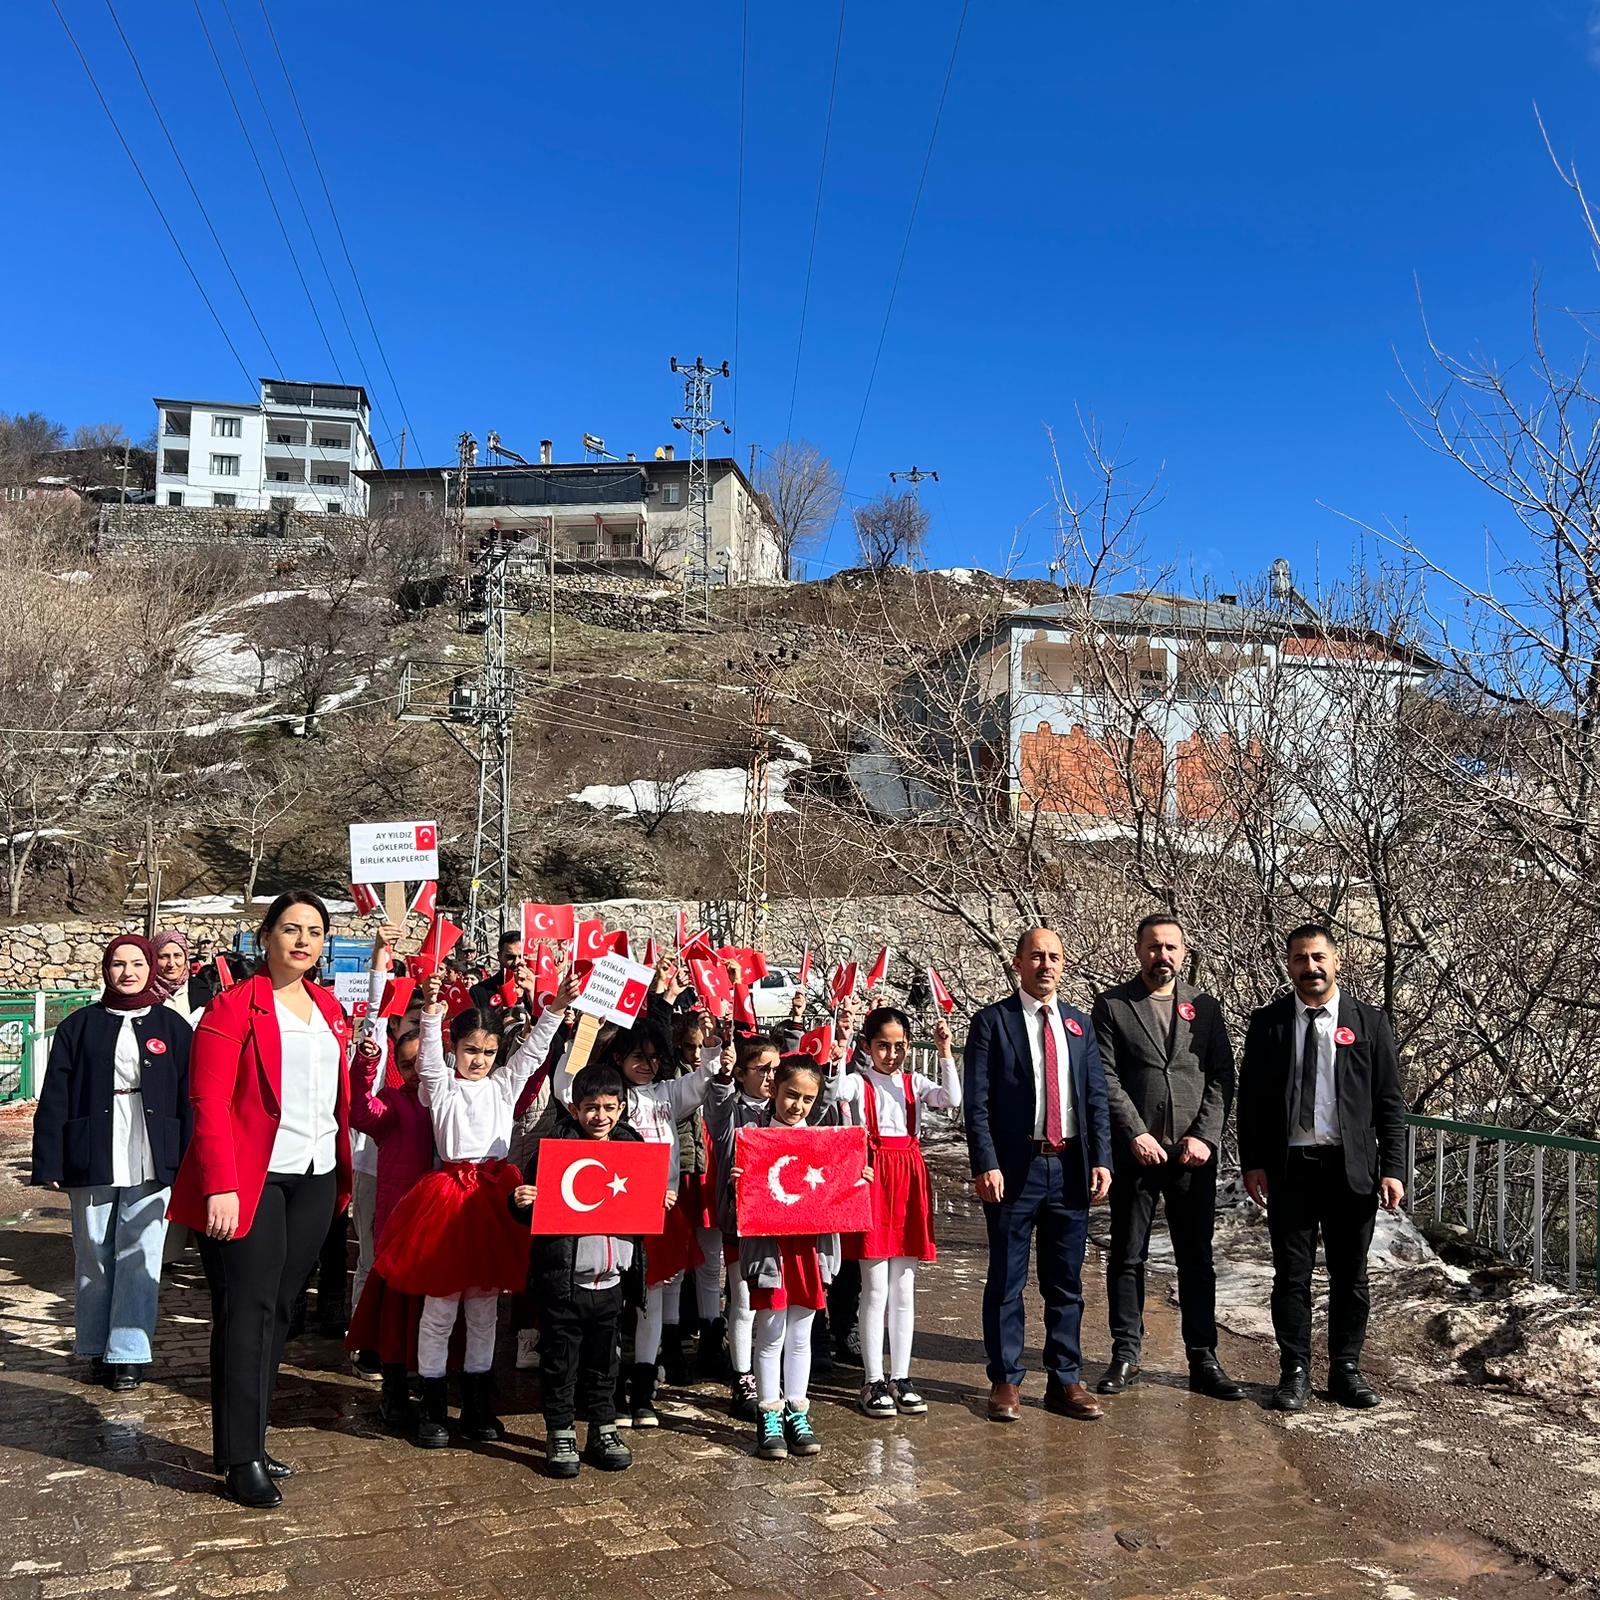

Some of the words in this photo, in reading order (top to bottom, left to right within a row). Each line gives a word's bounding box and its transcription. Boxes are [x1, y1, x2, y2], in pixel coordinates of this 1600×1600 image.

[360, 856, 385, 864] BİRLİK
[386, 855, 430, 863] KALPLERDE
[593, 969, 625, 986] BAYRAKLA
[590, 982, 616, 998] İSTİKBAL
[583, 993, 614, 1009] MAARİFLE
